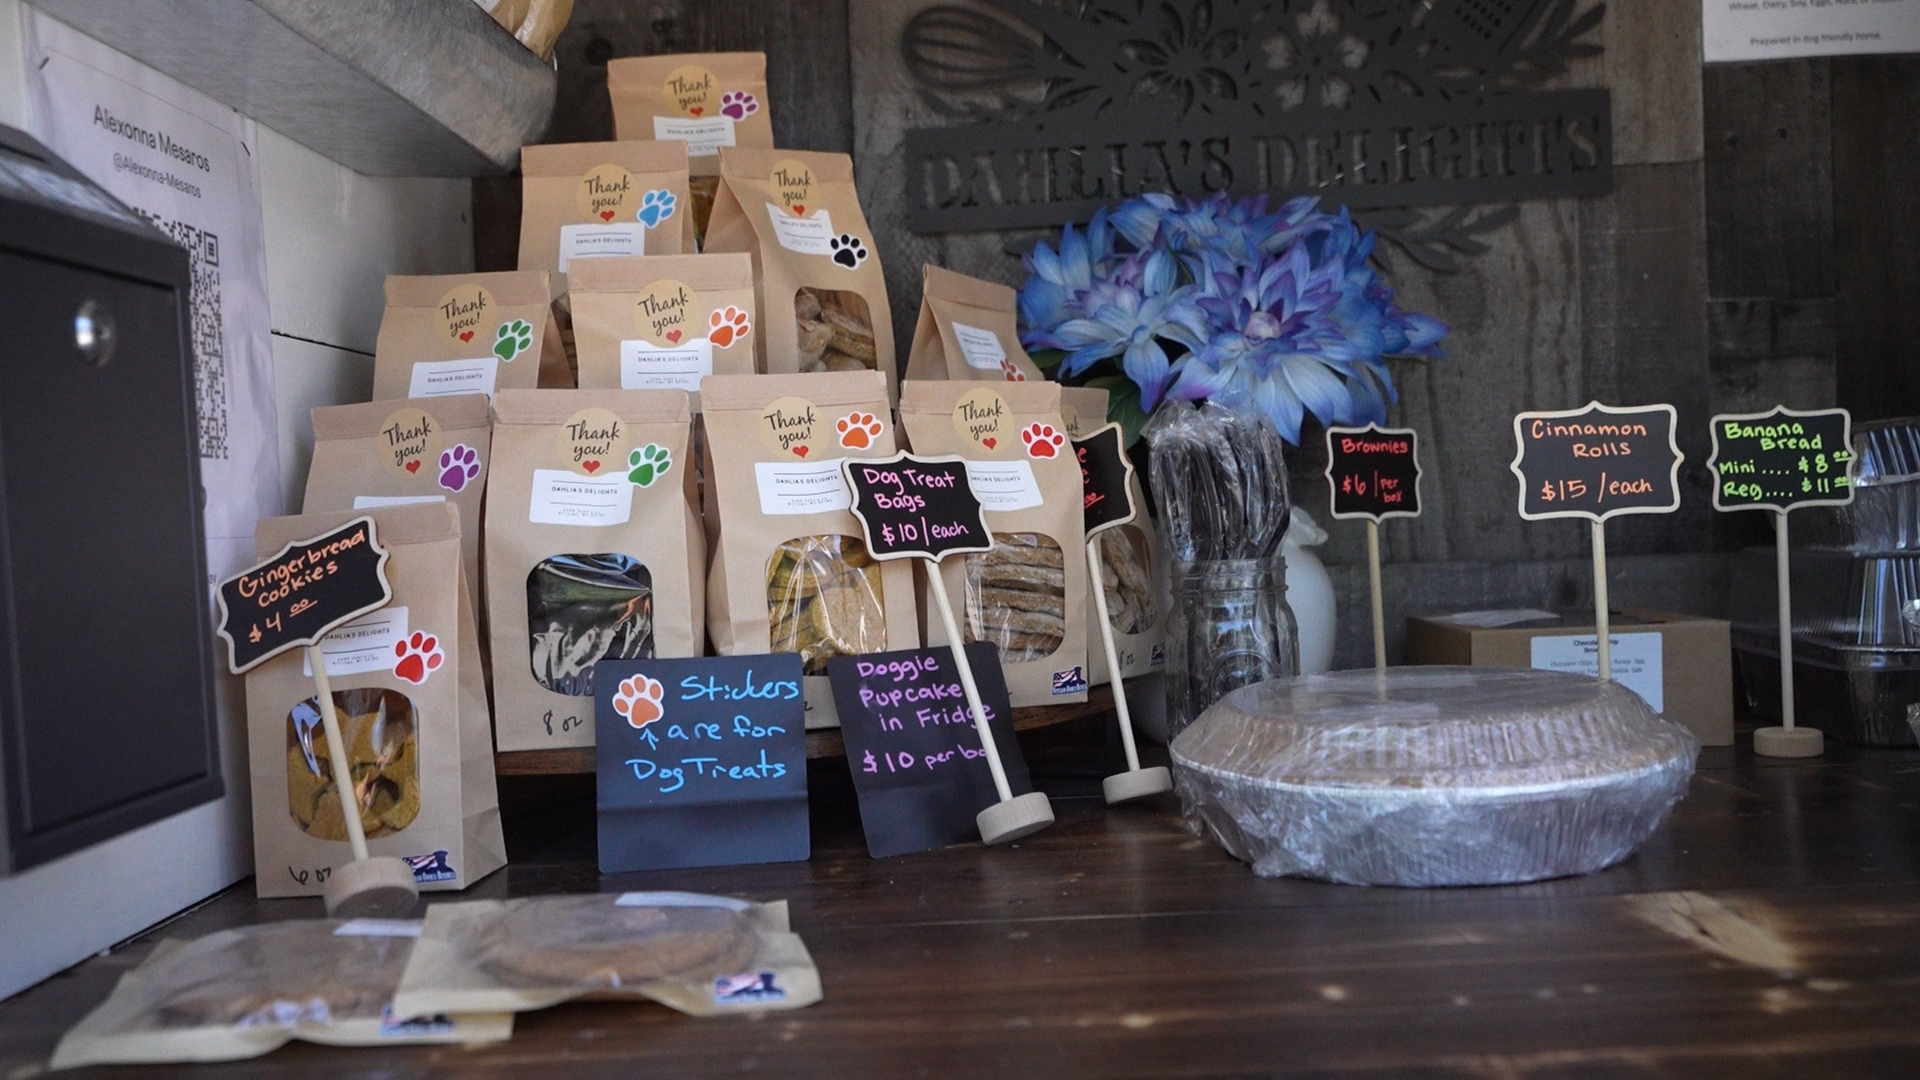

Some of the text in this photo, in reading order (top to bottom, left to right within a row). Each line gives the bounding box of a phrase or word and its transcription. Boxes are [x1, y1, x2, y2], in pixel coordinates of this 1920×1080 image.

[1750, 36, 1791, 46] Prepared
[1803, 36, 1819, 44] dog
[1821, 32, 1854, 42] friendly
[668, 73, 712, 95] Thank
[678, 92, 707, 110] you!
[93, 104, 210, 172] Alexonna Mesaros
[917, 115, 1603, 209] DAHLIA'S DELIGHTS
[113, 152, 202, 198] @Alexonna-Mesaros
[584, 174, 630, 195] Thank
[774, 168, 811, 187] Thank
[592, 195, 623, 213] you!
[783, 190, 807, 206] you!
[440, 291, 486, 319] Thank
[638, 287, 689, 317] Thank
[450, 312, 480, 338] you!
[653, 308, 685, 337] you!
[764, 406, 816, 431] Thank
[958, 398, 1003, 421] Thank
[383, 416, 432, 446] Thank
[566, 420, 620, 441] Thank
[779, 427, 811, 450] you!
[970, 419, 999, 441] you!
[1531, 419, 1648, 439] Cinnamon
[1724, 422, 1804, 439] Banana
[395, 439, 426, 467] you!
[574, 442, 610, 462] you!
[1341, 438, 1408, 454] Brownies
[1572, 442, 1632, 458] Rolls
[1760, 434, 1822, 451] Bread
[806, 475, 838, 484] DELIGHTS
[863, 468, 955, 495] Dog Treat
[584, 487, 618, 495] DELIGHTS
[1383, 491, 1403, 503] box
[874, 493, 926, 513] Bags
[238, 529, 366, 597] Gingerbread
[357, 628, 390, 637] DELIGHTS
[857, 655, 939, 682] Doggie
[680, 670, 799, 701] Stickers
[859, 683, 962, 708] Pupcake
[667, 714, 786, 740] are for
[879, 714, 903, 731] in
[863, 744, 987, 773] $10 per bo
[625, 749, 787, 792] Dog Treats
